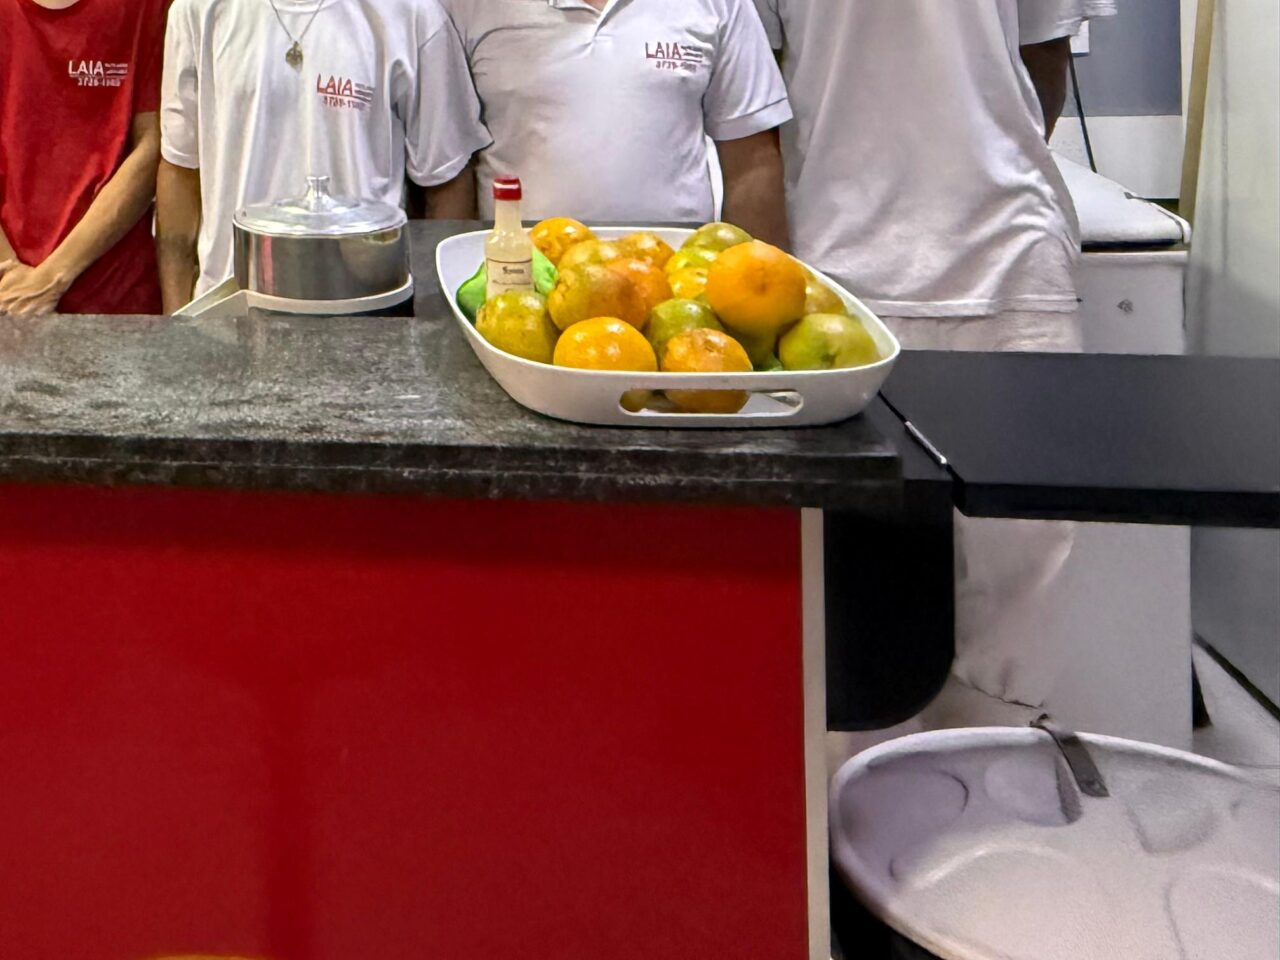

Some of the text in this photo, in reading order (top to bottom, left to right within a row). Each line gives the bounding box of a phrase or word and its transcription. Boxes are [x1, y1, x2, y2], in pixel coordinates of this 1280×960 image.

[646, 41, 682, 60] LAIA
[68, 60, 104, 76] LAIA
[317, 73, 353, 96] LAIA
